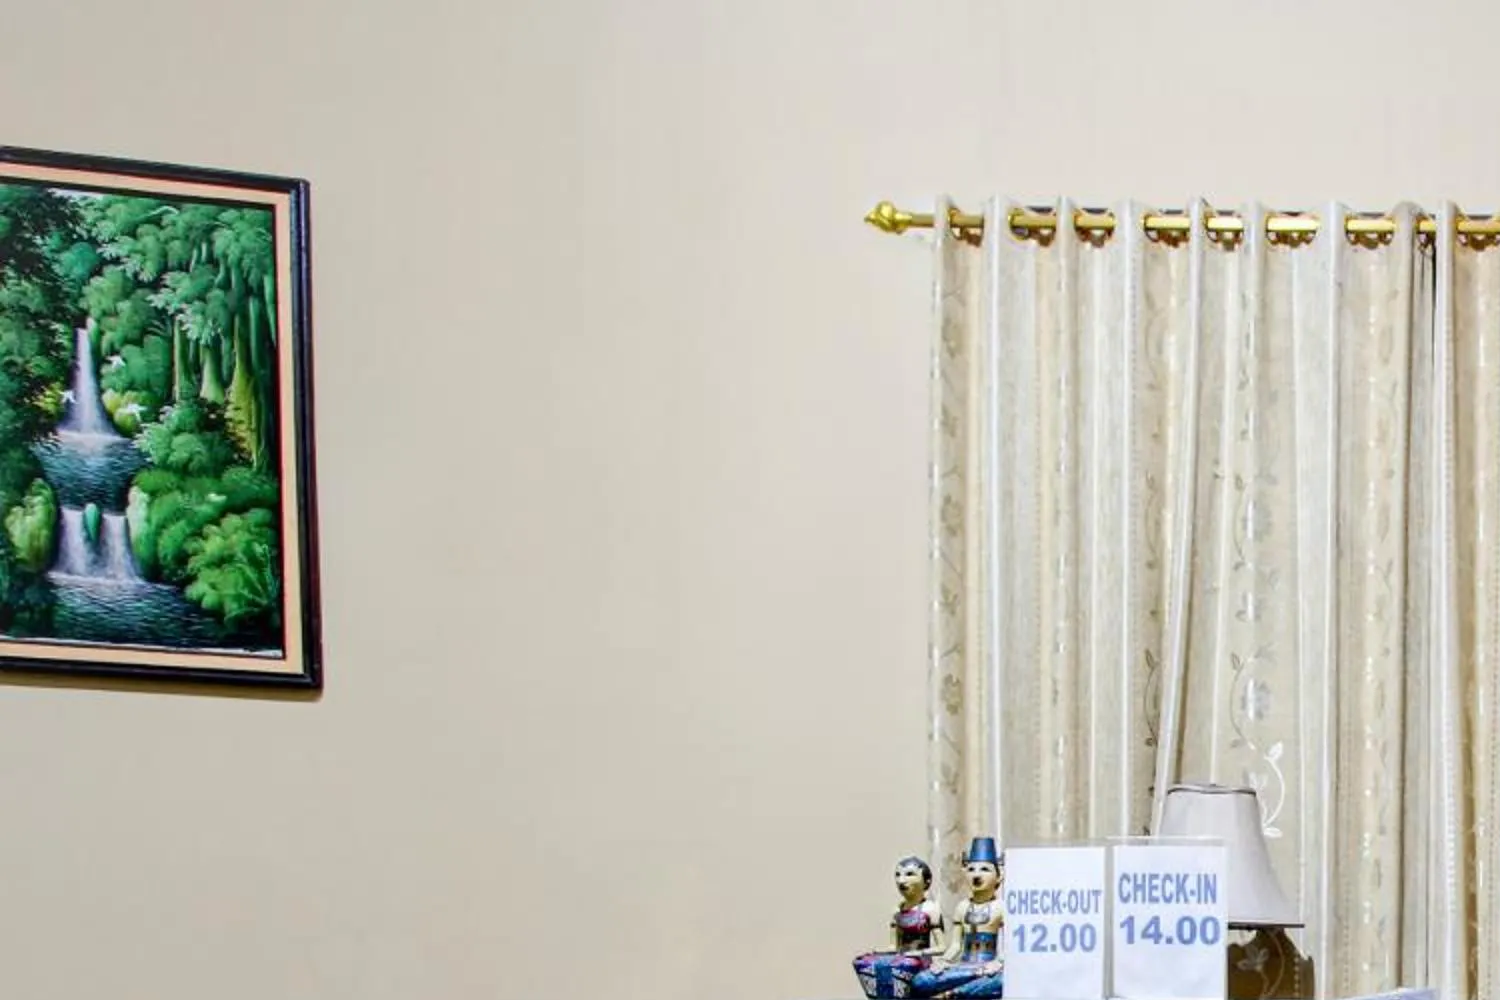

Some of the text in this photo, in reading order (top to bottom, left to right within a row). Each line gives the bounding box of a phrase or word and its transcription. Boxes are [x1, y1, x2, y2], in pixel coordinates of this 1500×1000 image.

[1006, 889, 1102, 915] CHECK-OUT
[1118, 873, 1218, 905] CHECK-IN
[1013, 923, 1097, 953] 12.00
[1119, 915, 1221, 945] 14.00
